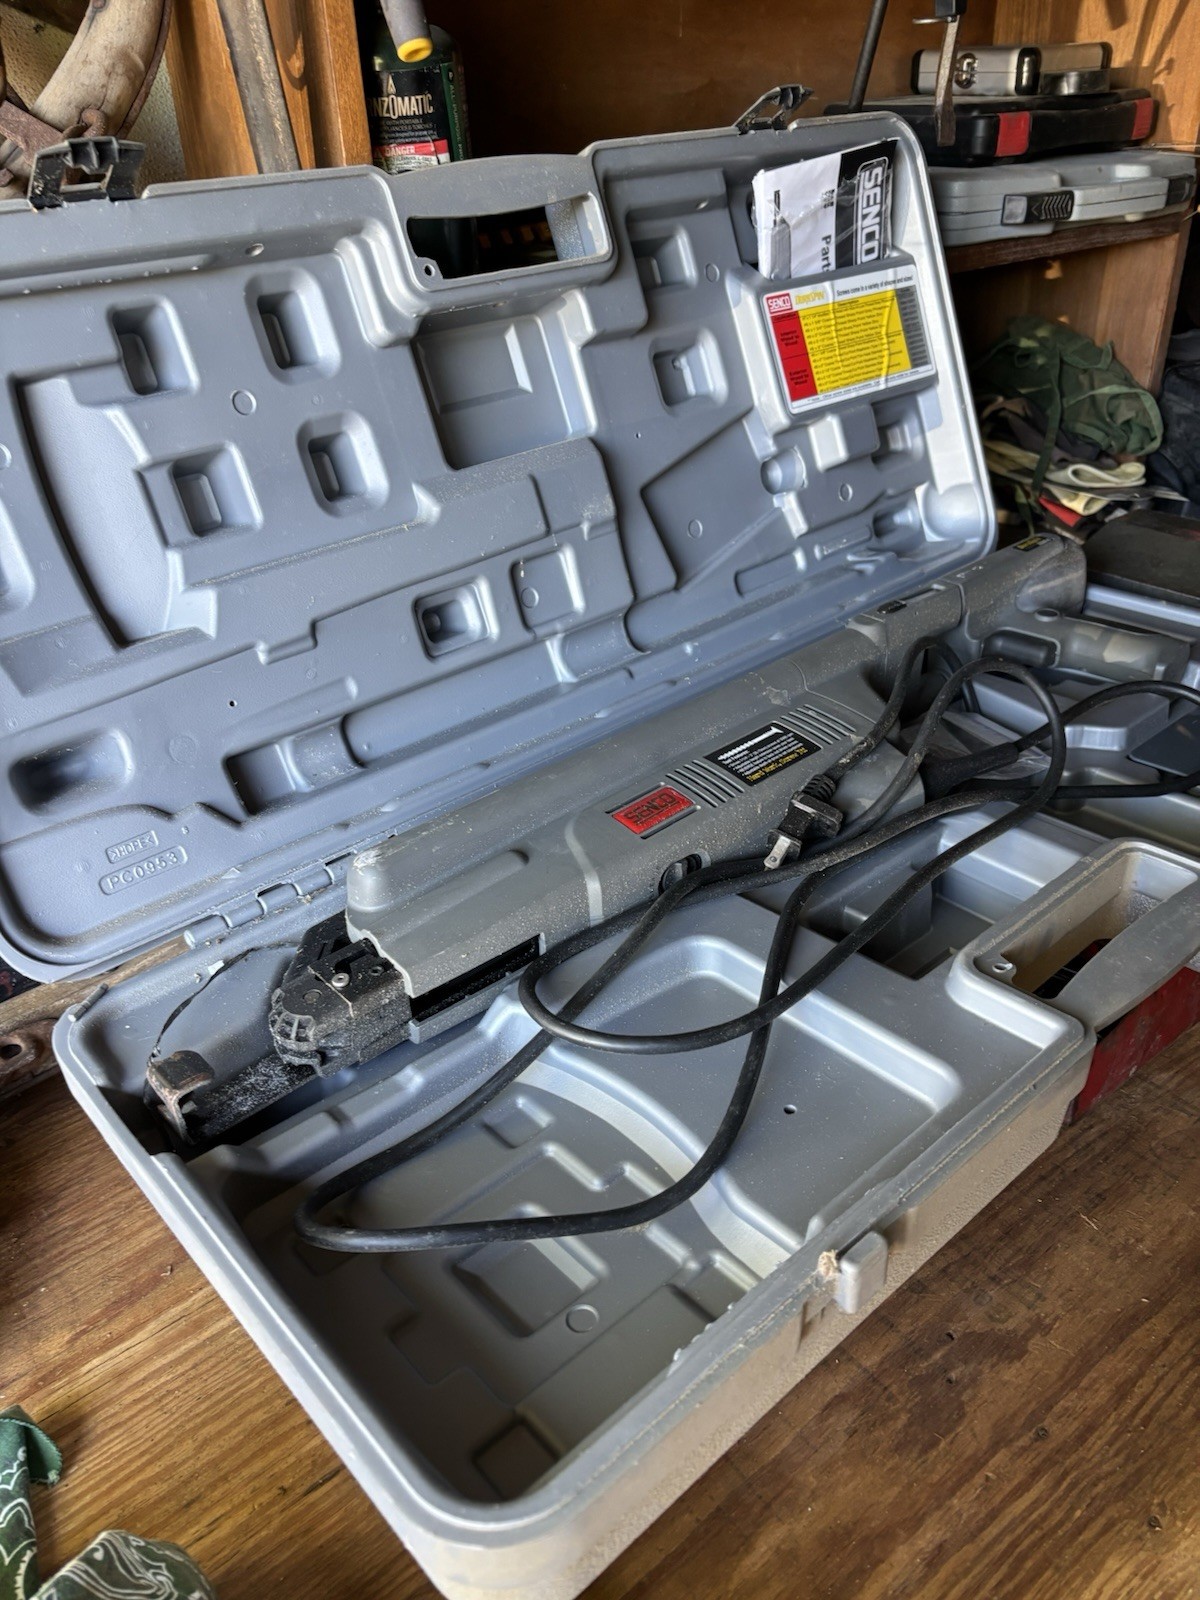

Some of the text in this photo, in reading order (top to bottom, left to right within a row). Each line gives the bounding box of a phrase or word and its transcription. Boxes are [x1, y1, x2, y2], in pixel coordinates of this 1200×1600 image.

[369, 93, 434, 119] NZOMATIC
[385, 145, 415, 157] DANGER
[861, 166, 883, 263] SENCO
[767, 295, 791, 310] SENCO
[624, 793, 677, 822] SENCO
[107, 852, 178, 889] PC0953
